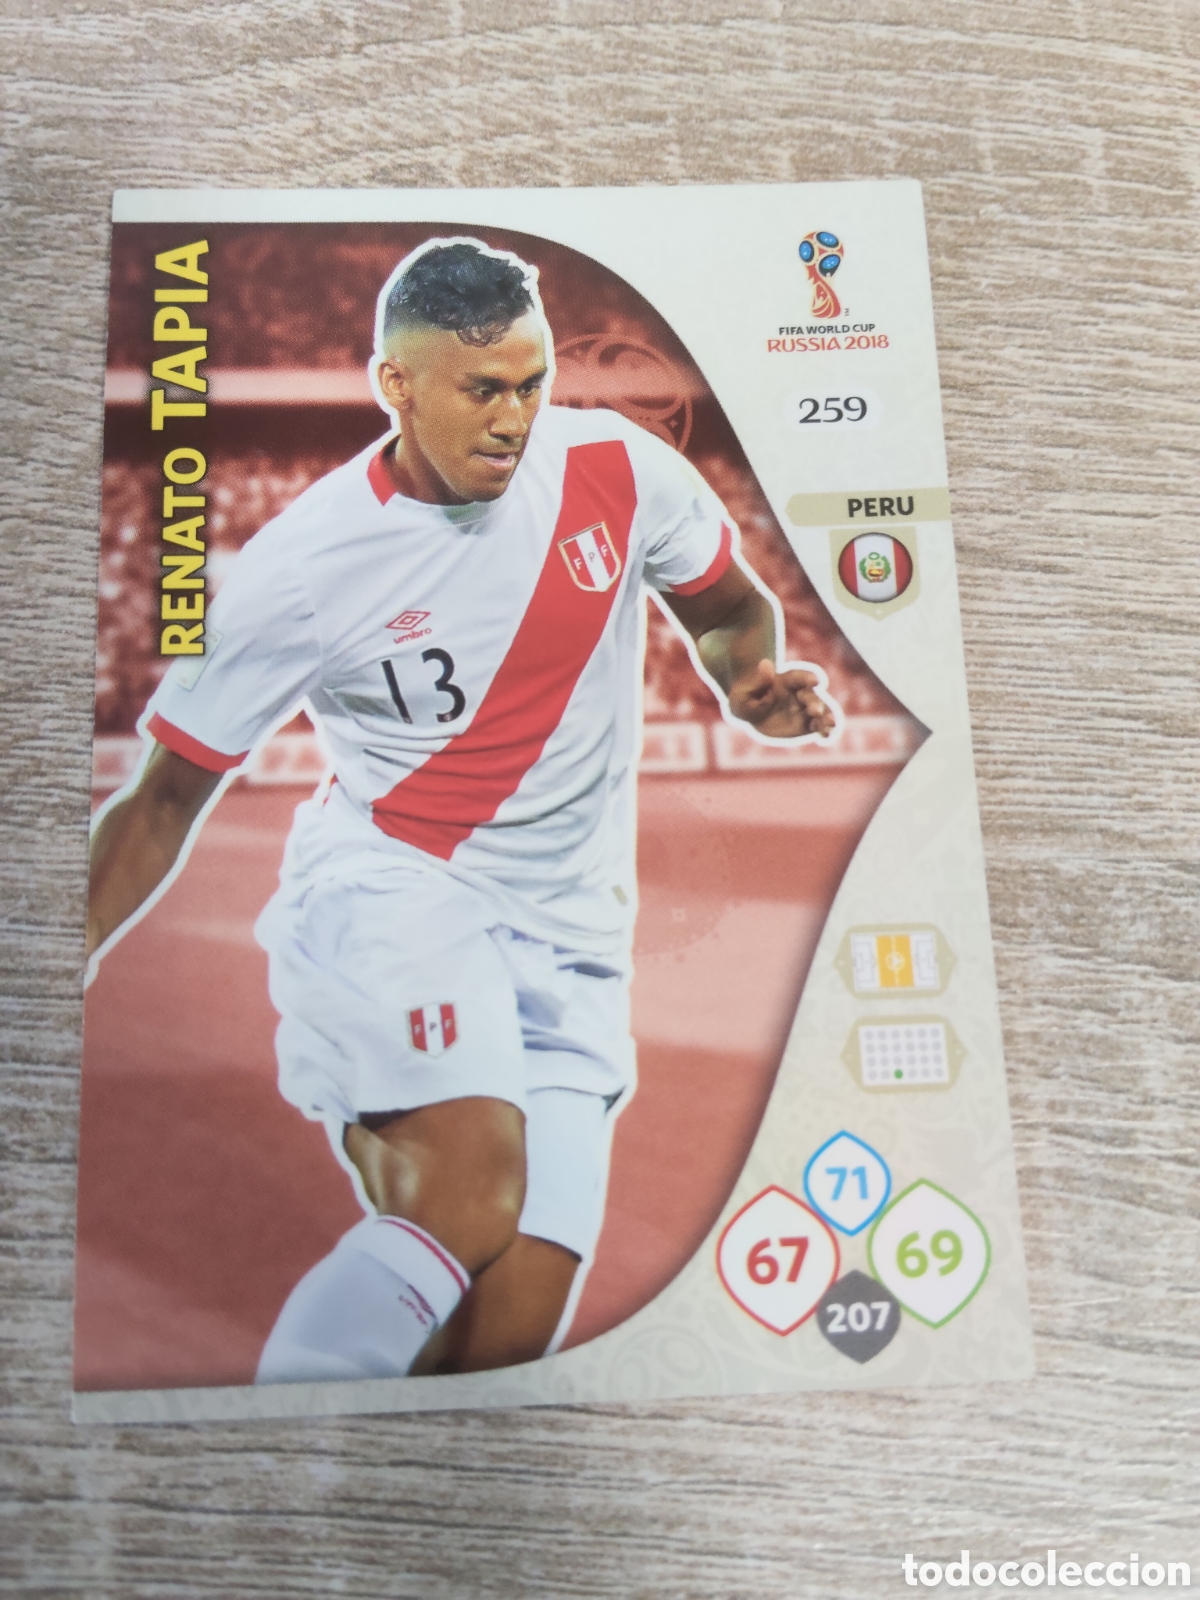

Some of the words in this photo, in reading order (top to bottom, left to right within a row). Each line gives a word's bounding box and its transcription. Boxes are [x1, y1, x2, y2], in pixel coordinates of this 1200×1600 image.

[151, 238, 210, 431] TAPIA
[767, 336, 842, 353] RUSSIA
[844, 334, 890, 351] 2018
[778, 326, 804, 336] FIFA
[806, 324, 850, 335] WORLD
[852, 323, 876, 333] CUP
[798, 396, 868, 424] 259
[847, 496, 914, 518] PERU
[160, 447, 207, 657] RENATO
[393, 626, 432, 644] umbro
[381, 647, 466, 724] 13
[825, 1166, 869, 1201] 71
[746, 1236, 809, 1285] 67
[896, 1229, 963, 1279] 69
[825, 1301, 891, 1333] 207
